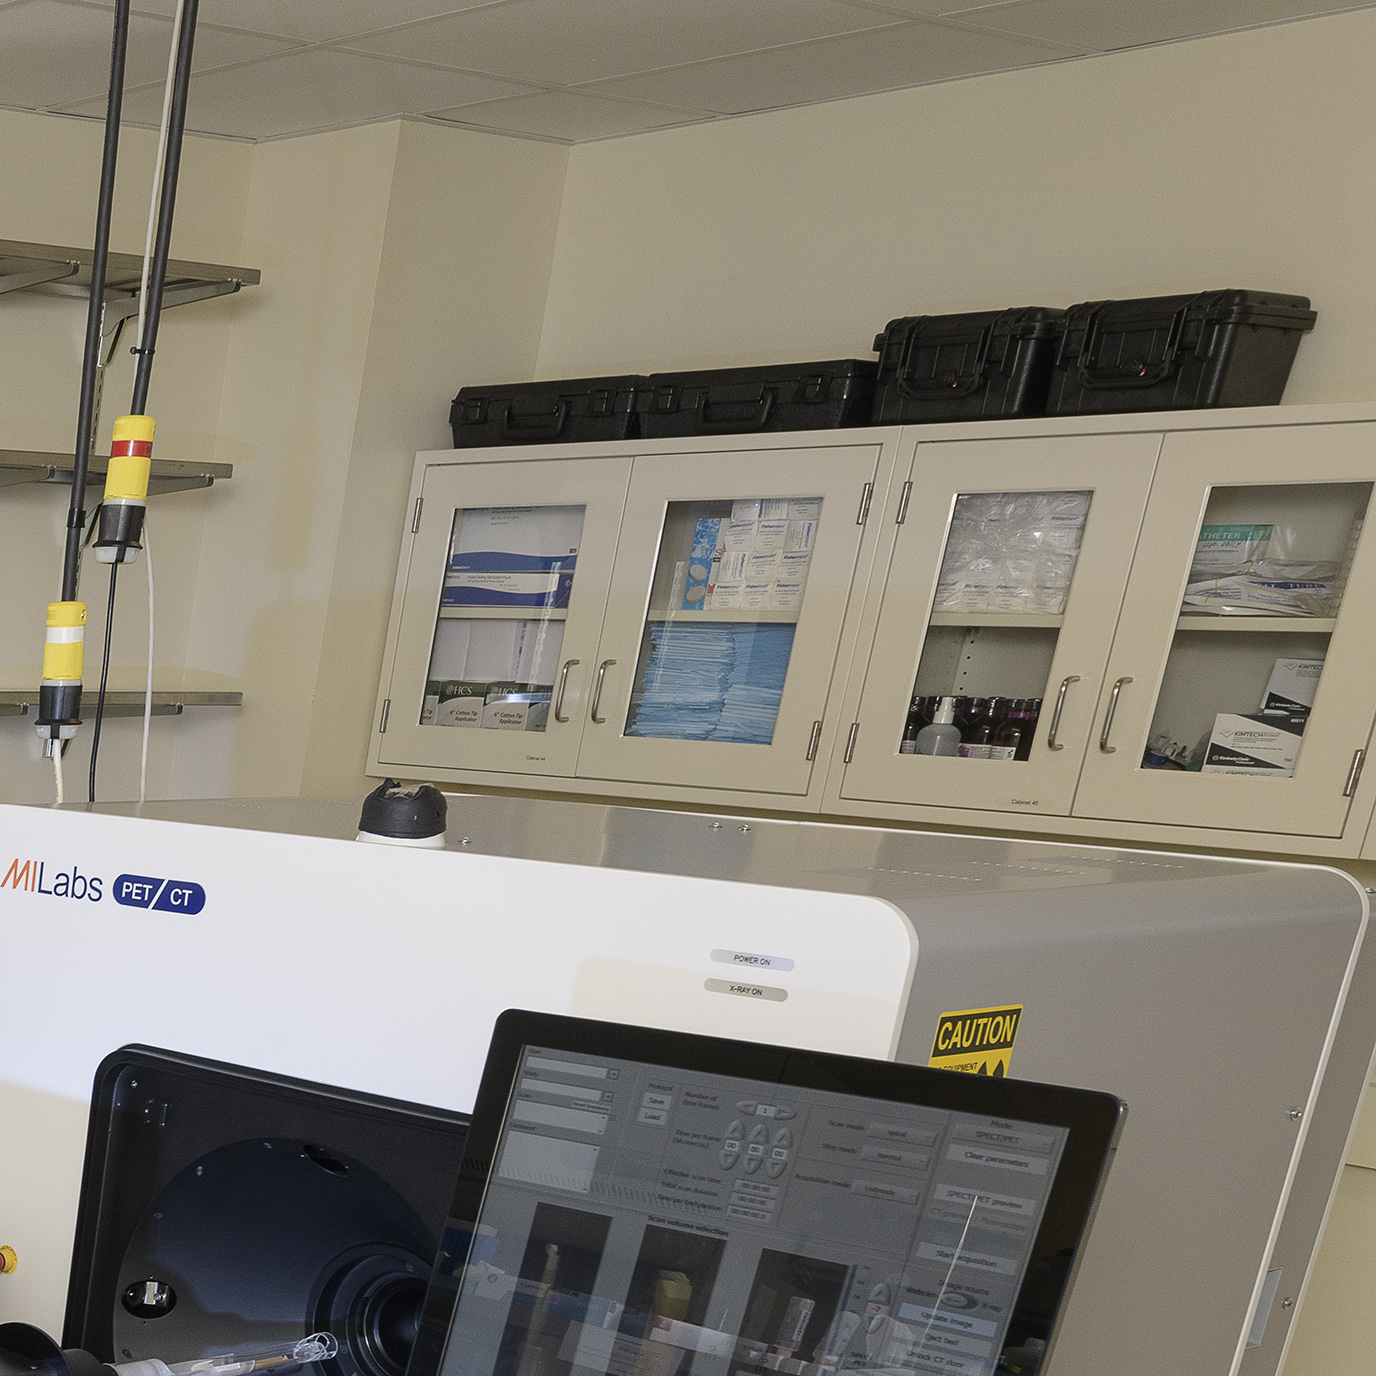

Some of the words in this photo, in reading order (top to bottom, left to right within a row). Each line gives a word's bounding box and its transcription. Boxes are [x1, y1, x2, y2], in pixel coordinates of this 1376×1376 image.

[1198, 531, 1242, 540] THETER
[453, 685, 473, 696] HCS
[454, 715, 478, 723] Applicator
[1011, 798, 1032, 806] Cabinet
[0, 857, 104, 903] MILabs
[733, 953, 758, 966] POWER
[758, 957, 772, 967] ON
[729, 984, 752, 996] X-RAY
[751, 986, 764, 997] ON
[936, 1014, 1018, 1051] CAUTION
[644, 1112, 661, 1121] Load
[964, 1151, 985, 1161] Clear
[986, 1155, 1030, 1169] parameters
[992, 1198, 1024, 1210] preview
[648, 1214, 665, 1224] Scan
[666, 1218, 695, 1231] volume
[695, 1224, 730, 1239] selection
[949, 1316, 975, 1329] image
[945, 1336, 959, 1346] bed
[933, 1355, 945, 1363] CT
[946, 1358, 966, 1369] door
